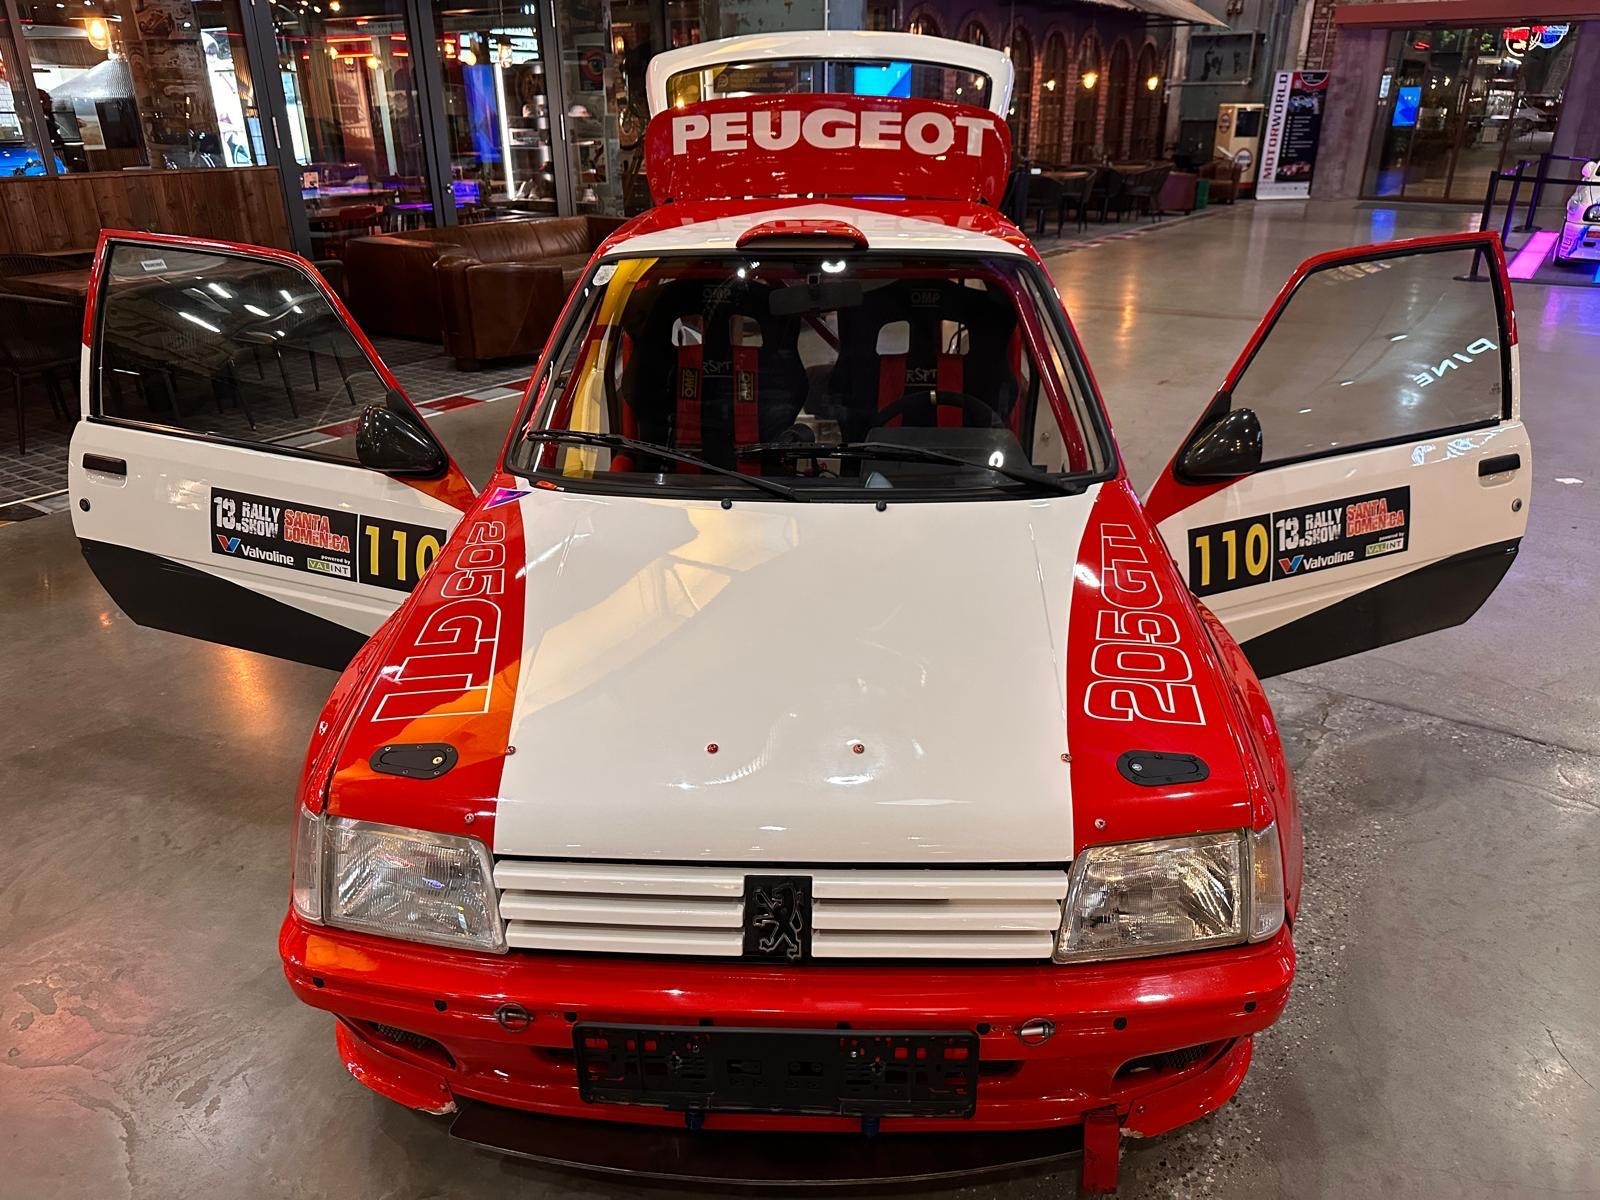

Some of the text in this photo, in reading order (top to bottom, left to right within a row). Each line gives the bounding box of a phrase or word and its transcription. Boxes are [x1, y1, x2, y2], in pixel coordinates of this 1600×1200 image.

[672, 108, 995, 156] PEUGEOT
[1263, 74, 1289, 180] MOTORWORLD
[911, 291, 942, 304] OMP
[683, 370, 695, 398] OMP
[213, 496, 280, 531] 13. RALLY
[1346, 498, 1387, 520] SANTA
[241, 518, 278, 538] SHOW
[284, 509, 330, 533] SANTA
[1275, 508, 1342, 551] 13. RALLY
[1304, 525, 1341, 546] SHOW
[1378, 534, 1396, 542] powered
[241, 543, 294, 566] Valvoline
[366, 525, 440, 581] 110
[1195, 523, 1269, 586] 110
[1367, 539, 1403, 555] VALINT
[309, 560, 350, 576] VALINT
[321, 554, 343, 563] powered
[1303, 550, 1354, 570] Valvoline
